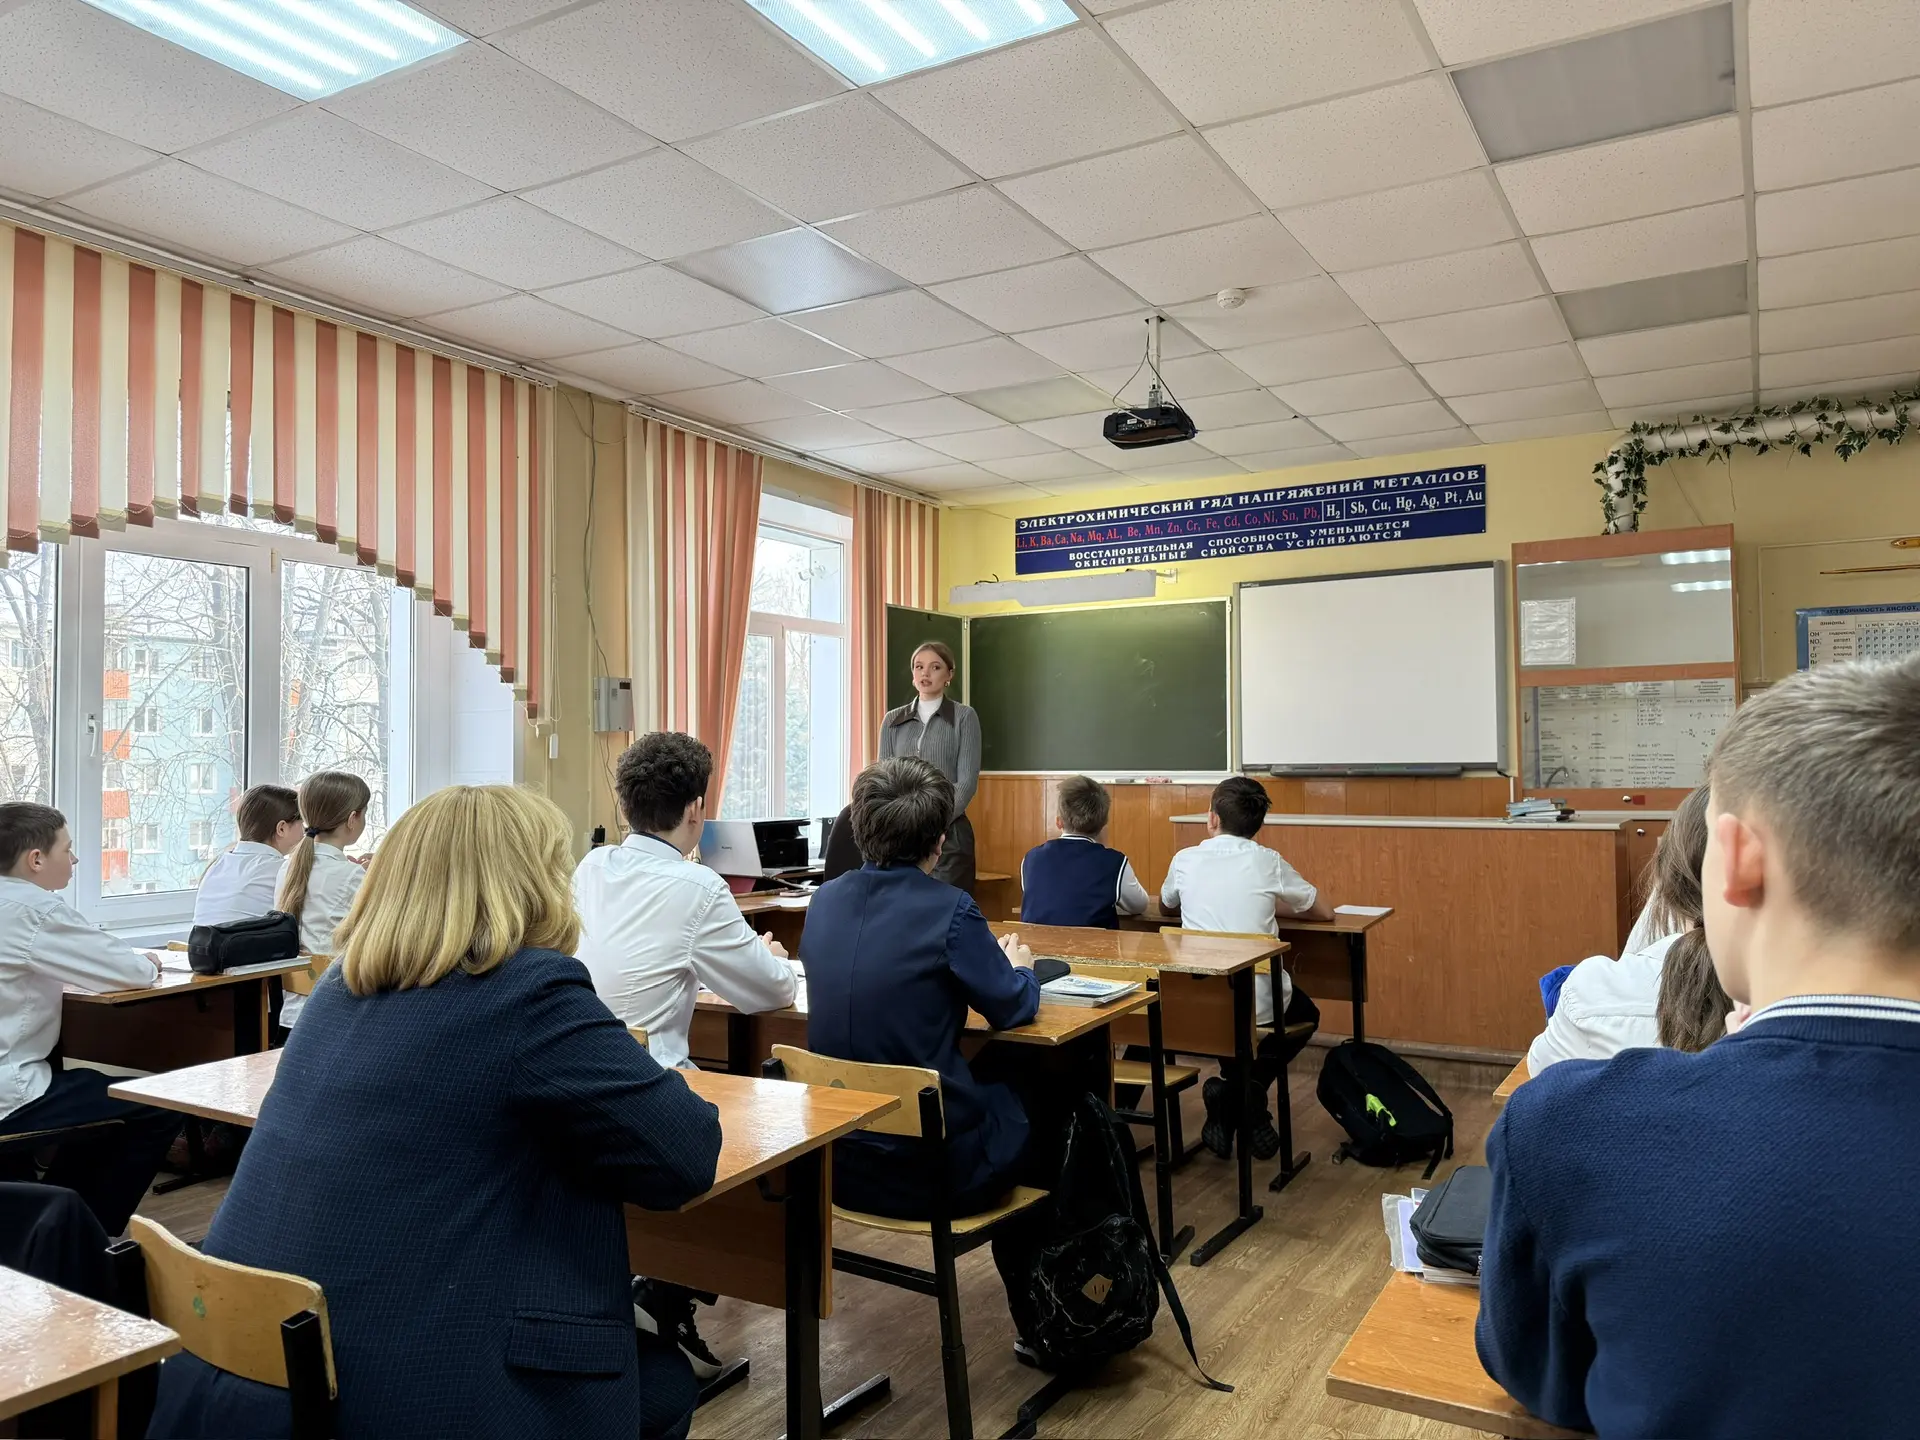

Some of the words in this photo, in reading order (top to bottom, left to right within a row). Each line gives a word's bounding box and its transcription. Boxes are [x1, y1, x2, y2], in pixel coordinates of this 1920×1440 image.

[1019, 500, 1194, 529] ЭЛЕКТРОХИМИЧЕСКИЙ
[1200, 495, 1234, 509] РЯД
[1239, 480, 1364, 505] НАПРЯЖЕНИЙ
[1373, 470, 1480, 490] МЕТАЛЛОВ
[1350, 501, 1368, 516] Sb,
[1372, 498, 1391, 512] Cu,
[1396, 496, 1416, 512] Hg,
[1420, 493, 1440, 510] Ag,
[1444, 492, 1462, 506] Pt,
[1465, 489, 1483, 502] Au
[1069, 541, 1194, 562] ВОССТАНОВИТЕЛЬНАЯ
[1208, 530, 1299, 547] СПОСОБНОСТЬ
[1310, 519, 1410, 538] УМЕНЬШАЕТСЯ
[1074, 550, 1187, 570] ОКИСЛИТЕЛЬНЫЕ
[1200, 542, 1274, 558] СВОЙСТВА
[1286, 530, 1402, 549] УСИЛИВАЮТСЯ
